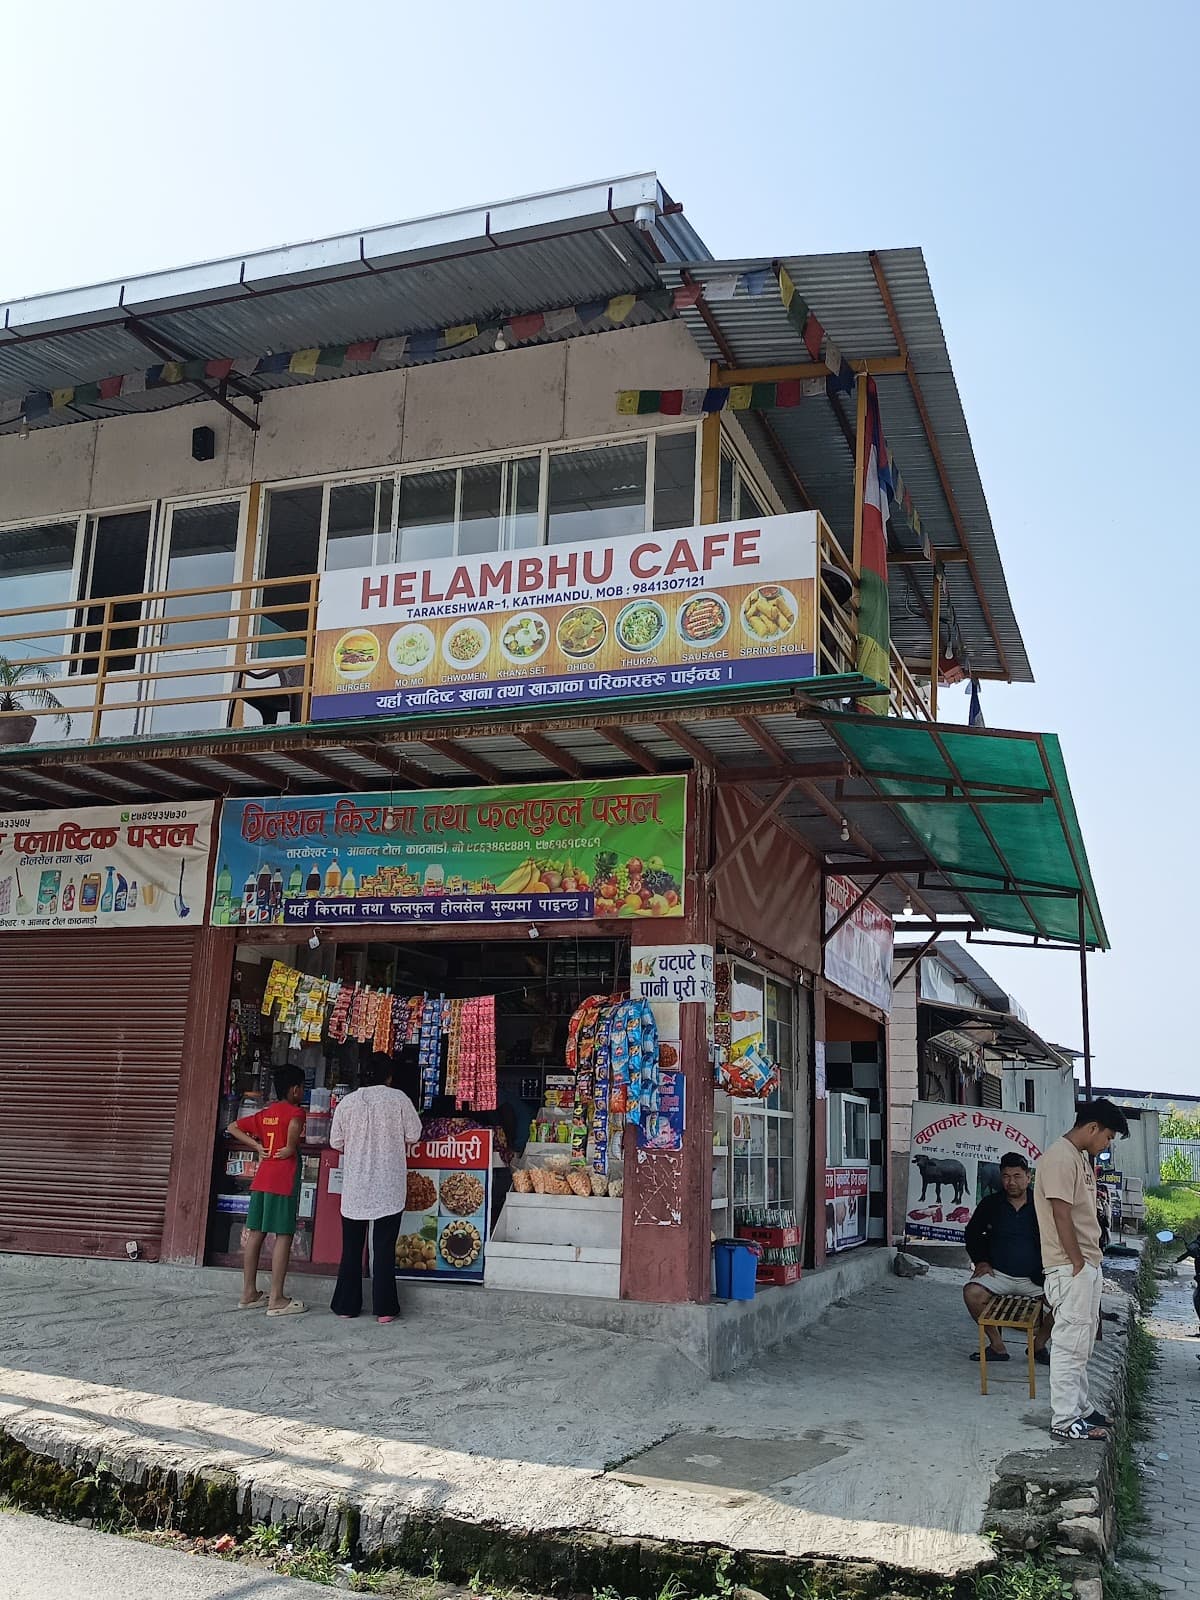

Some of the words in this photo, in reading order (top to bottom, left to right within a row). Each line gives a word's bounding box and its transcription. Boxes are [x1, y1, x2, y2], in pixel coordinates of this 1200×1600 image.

[361, 547, 614, 610] HELAMBHU
[629, 529, 761, 580] CAFE
[596, 585, 623, 599] MOB
[632, 576, 705, 595] 9841307121
[681, 650, 729, 662] SAUSAGE
[739, 645, 777, 657] SPRING
[779, 643, 807, 654] ROLL
[496, 668, 528, 679] KHANA
[529, 665, 546, 676] SET
[621, 656, 659, 667] THUKPA
[336, 682, 371, 693] BURGER
[441, 672, 488, 684] CHWOMEIN
[405, 688, 455, 708] स्वादिष्ट
[458, 686, 493, 702] खाना
[497, 683, 525, 700] तथा
[528, 679, 584, 698] खाजाका
[333, 798, 419, 836] किराना
[422, 803, 472, 834] तथा
[476, 797, 587, 837] फलफुल
[591, 793, 664, 826] पसल
[14, 822, 120, 855] प्लाष्टिक
[127, 823, 199, 849] पसल
[55, 854, 73, 865] तथा
[345, 843, 380, 857] आनन्द
[288, 900, 309, 919] यहाँ
[314, 901, 356, 916] किराना
[361, 902, 385, 916] तथा
[390, 901, 436, 918] फलफुल
[440, 899, 485, 916] होलसेल
[490, 899, 532, 917] मुल्यमा
[538, 897, 579, 914] पाइन्छ
[640, 975, 669, 997] पानी
[673, 975, 697, 1001] पुरी
[426, 1135, 482, 1165] पानीपुरी
[1004, 1124, 1042, 1161] हाउस
